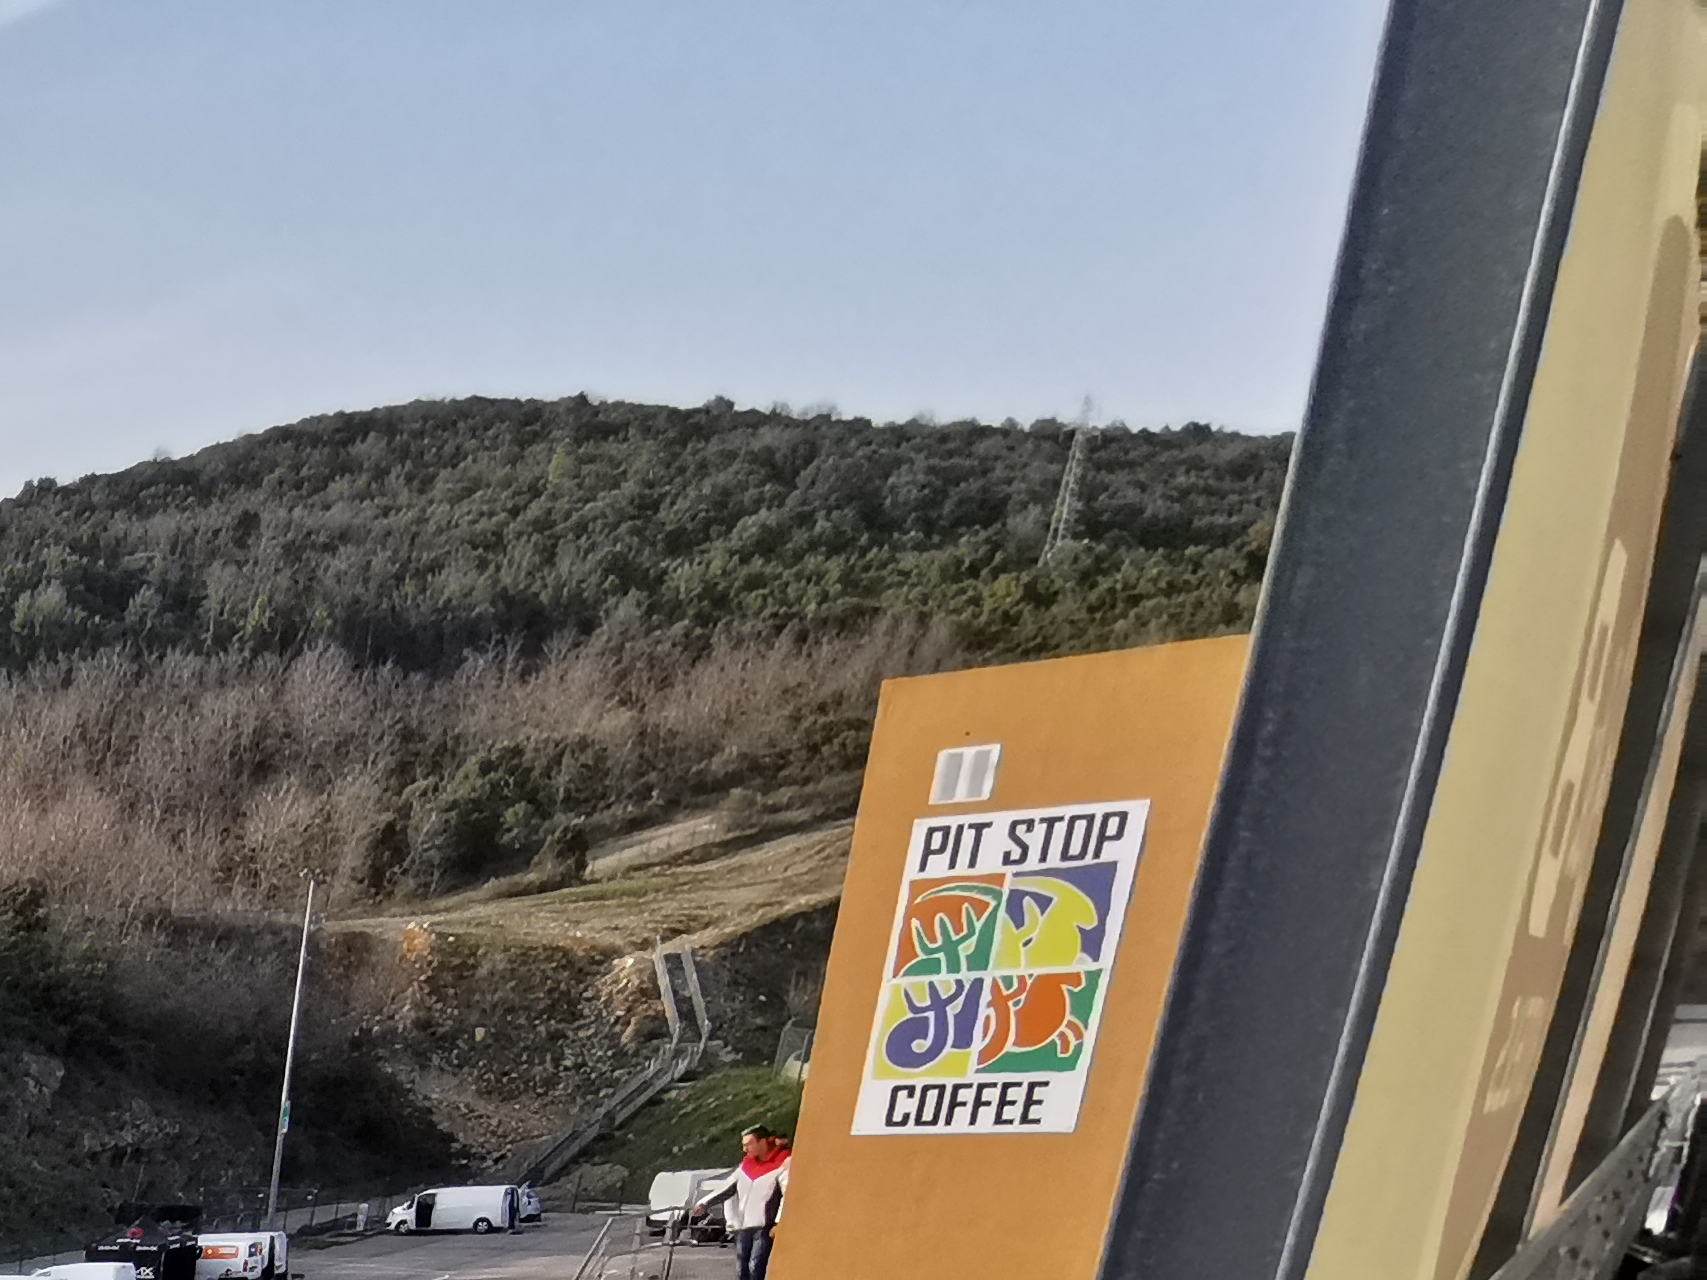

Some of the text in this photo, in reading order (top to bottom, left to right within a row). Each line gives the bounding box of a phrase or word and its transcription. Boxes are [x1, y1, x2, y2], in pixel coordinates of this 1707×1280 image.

[918, 810, 1129, 873] PIT STOP
[884, 1081, 1050, 1127] COFFEE
